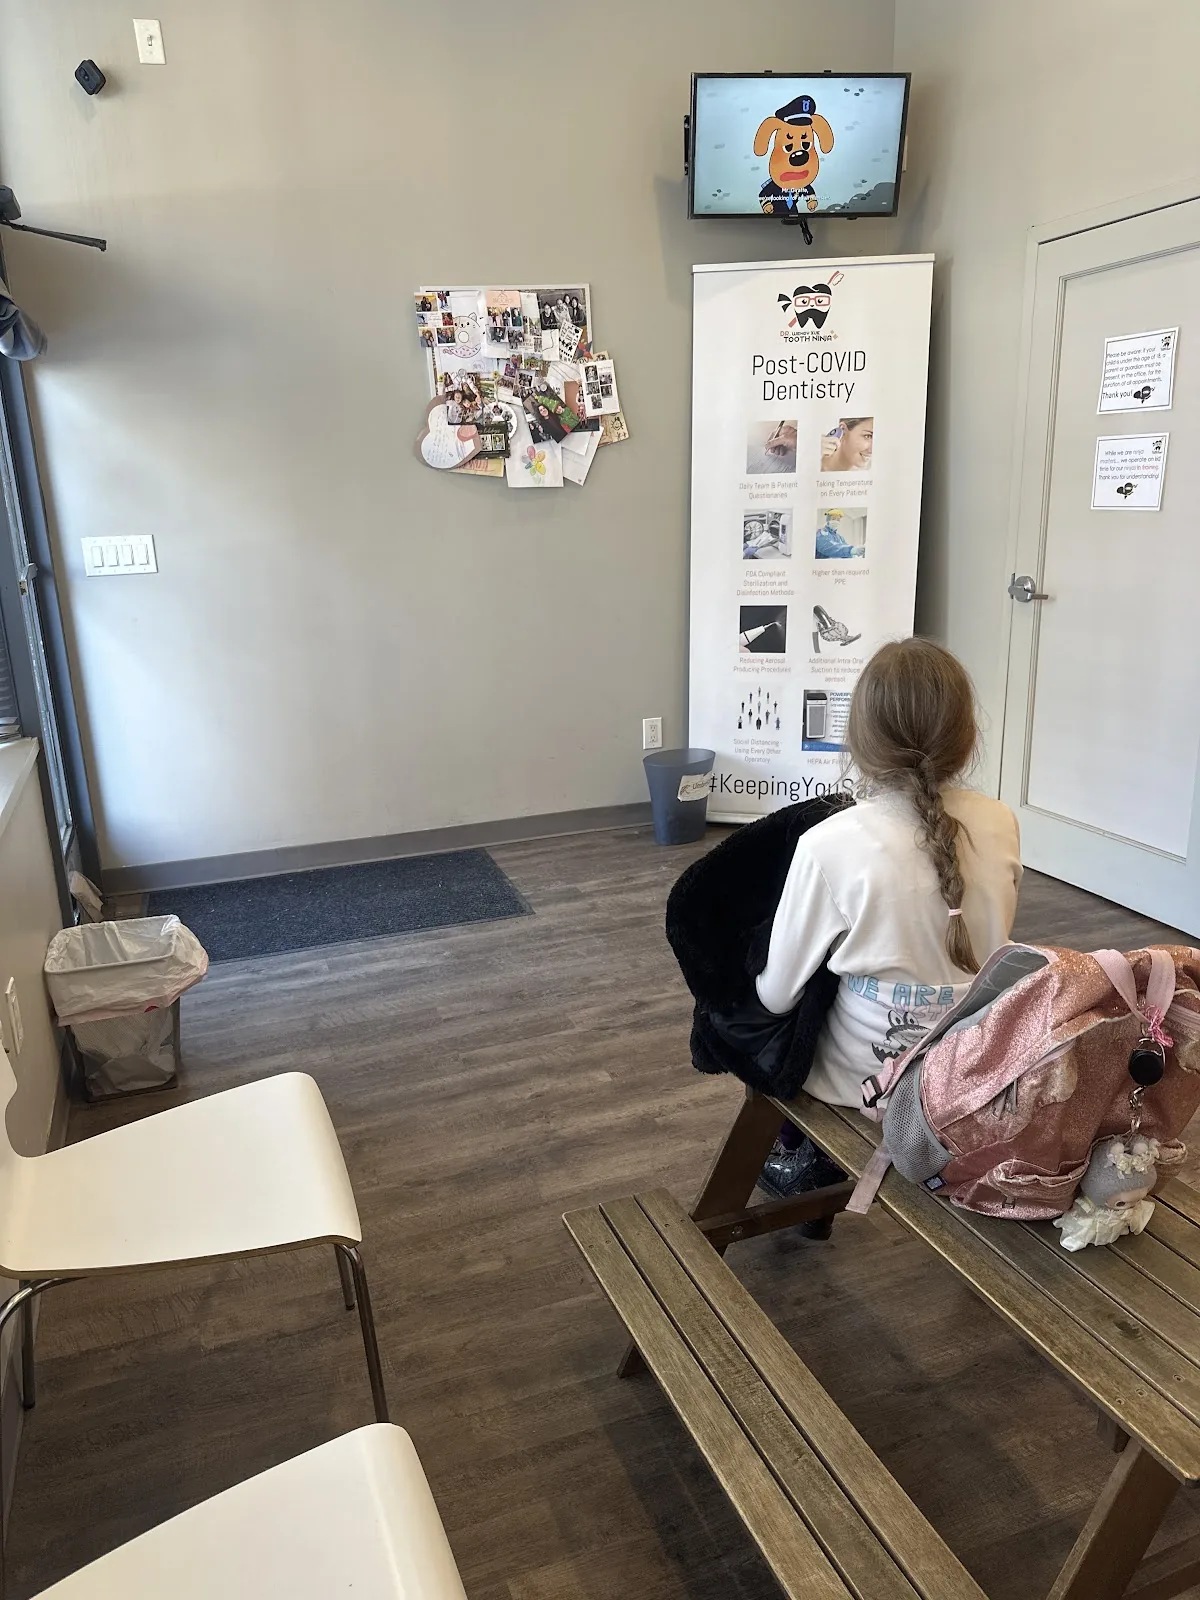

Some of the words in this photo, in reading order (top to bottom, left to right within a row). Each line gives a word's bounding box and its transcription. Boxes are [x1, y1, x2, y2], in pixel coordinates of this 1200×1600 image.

[752, 350, 866, 375] Post-COVID
[1125, 364, 1144, 372] guardian
[763, 378, 855, 403] Dentistry
[1102, 391, 1118, 399] Thank
[1120, 390, 1133, 398] you!
[739, 482, 753, 491] Daily
[816, 480, 835, 488] Taking
[837, 479, 873, 487] Temperature
[829, 490, 845, 498] Every
[758, 570, 786, 578] Compliant
[812, 569, 831, 577] Higher
[739, 657, 764, 665] Reducing
[751, 739, 779, 747] Distancing
[847, 973, 879, 1001] WE
[892, 982, 954, 1006] ARE
